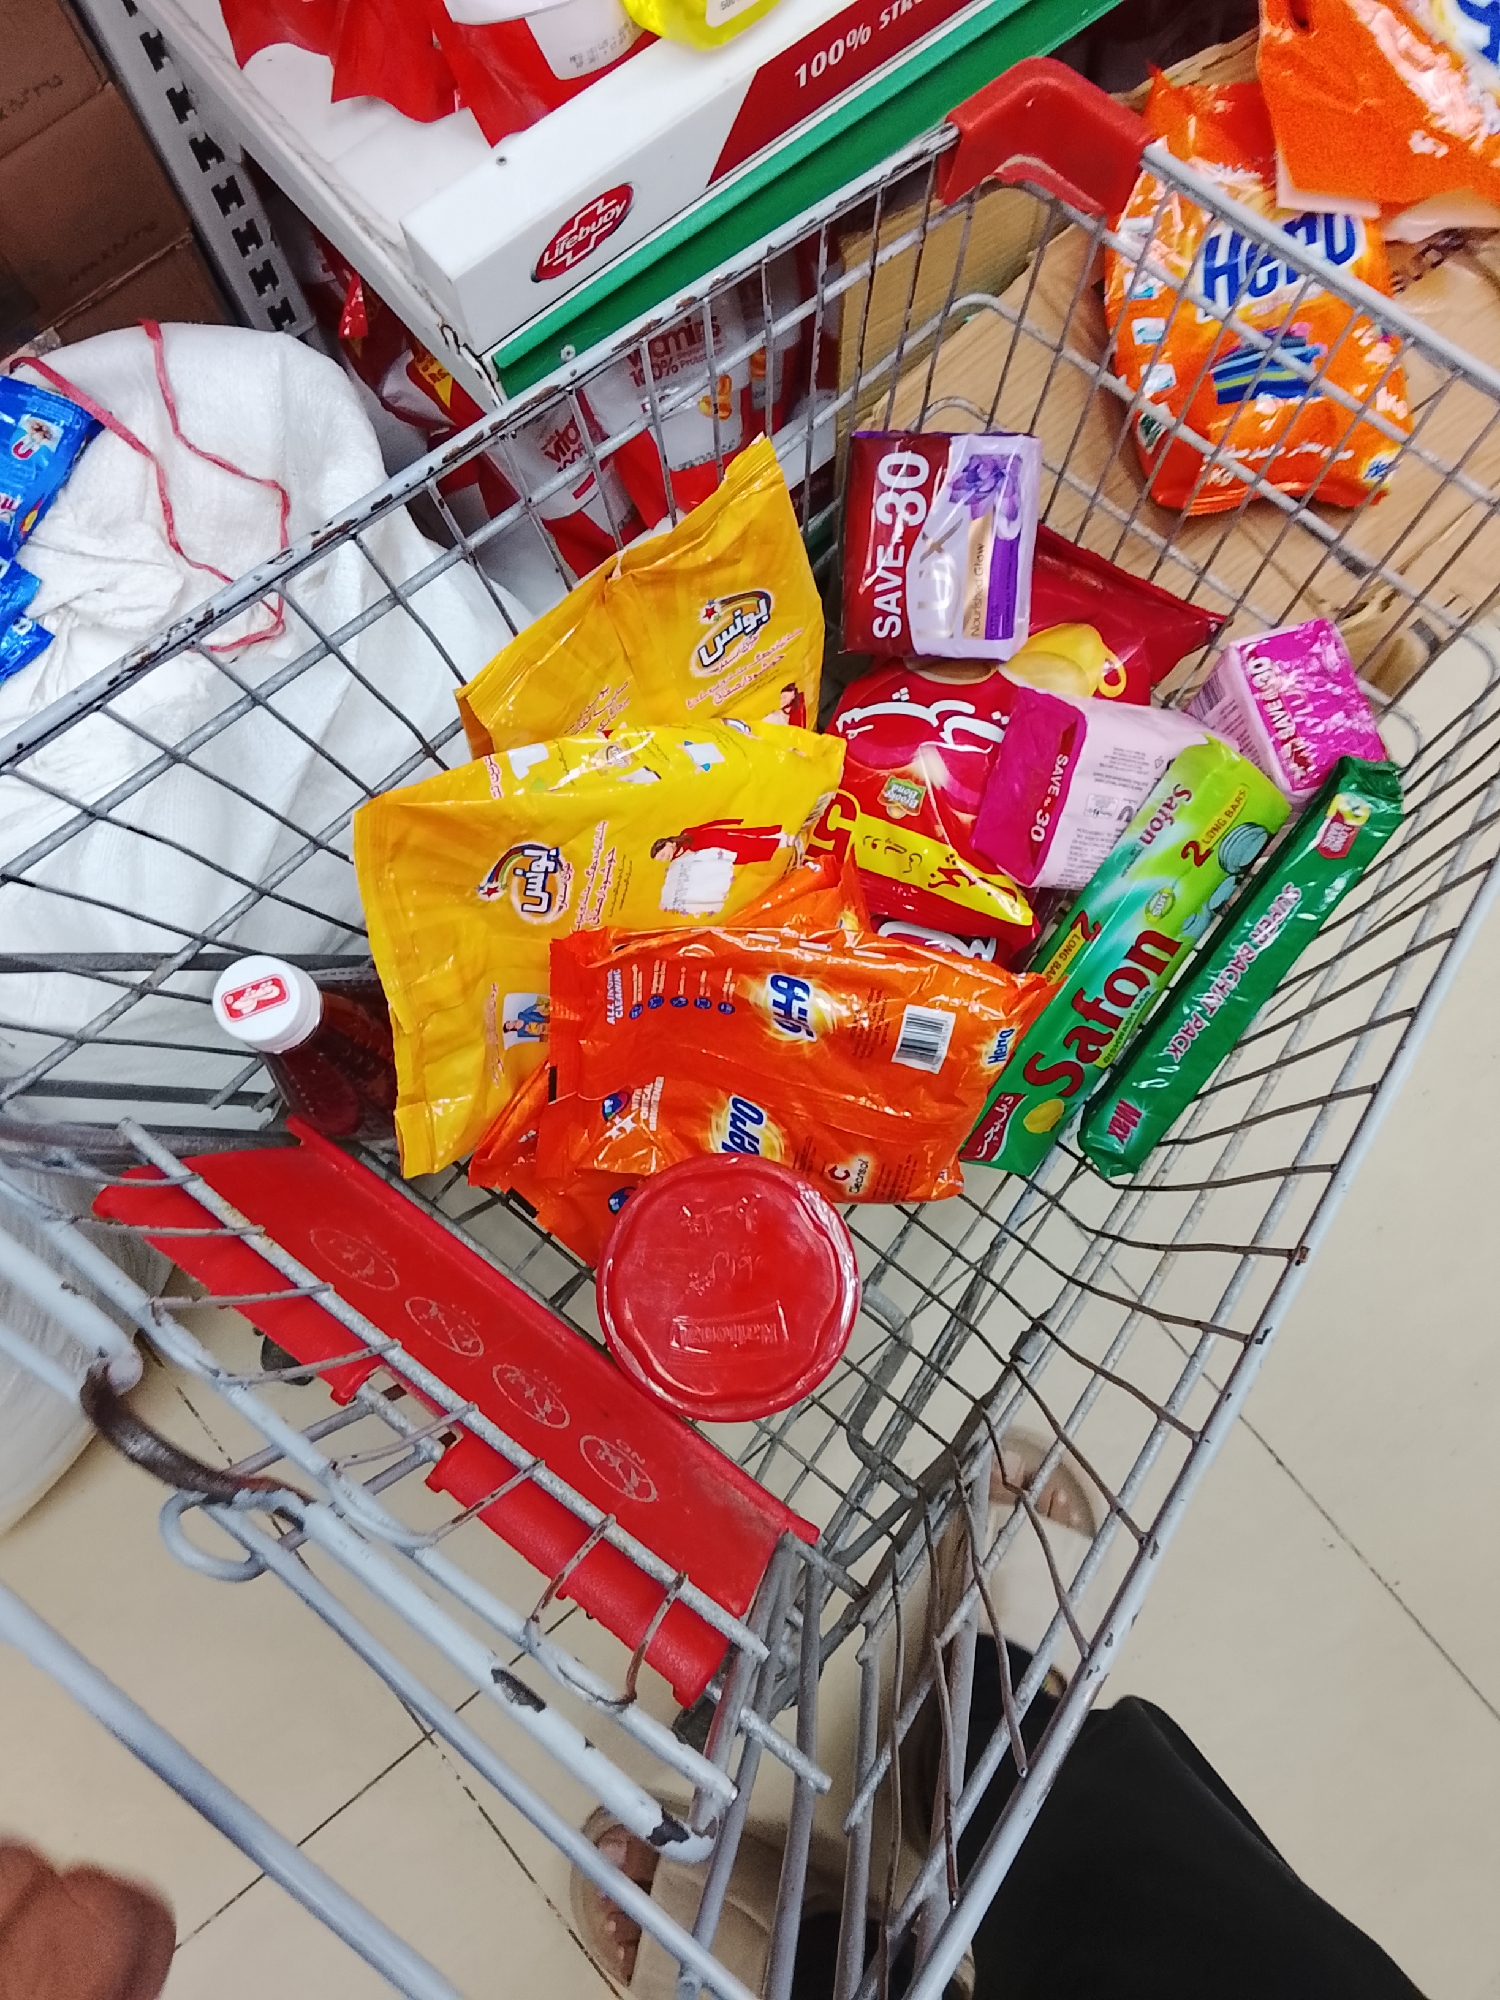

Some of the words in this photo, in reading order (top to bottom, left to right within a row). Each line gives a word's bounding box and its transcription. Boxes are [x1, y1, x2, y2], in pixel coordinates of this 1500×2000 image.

[795, 22, 871, 88] 100%
[542, 199, 625, 267] Lifebuoy
[875, 452, 931, 526] 30
[973, 543, 985, 576] Glow
[873, 545, 905, 637] SAVE
[970, 578, 983, 636] Nourished
[698, 598, 771, 668] بونس
[1263, 696, 1297, 741] SAVE
[883, 789, 918, 808] Brooke
[890, 783, 917, 798] Bond
[1049, 755, 1070, 795] SAVE
[1031, 809, 1054, 843] 30
[1138, 780, 1193, 848] Safon
[1181, 840, 1214, 867] 2
[1200, 815, 1228, 845] LONG
[1222, 787, 1249, 818] BARS
[522, 847, 560, 914] بونس
[1056, 932, 1081, 962] LONG
[1071, 910, 1102, 941] 2
[612, 967, 624, 1019] CLEANING
[1133, 990, 1150, 1011] BAR
[1195, 941, 1258, 1018] BACHAT
[606, 998, 616, 1025] ALL
[1023, 929, 1183, 1098] Safon
[1163, 1012, 1207, 1062] PACK
[988, 1028, 1015, 1065] Hero
[720, 1096, 767, 1154] ero
[1108, 1099, 1142, 1144] Max
